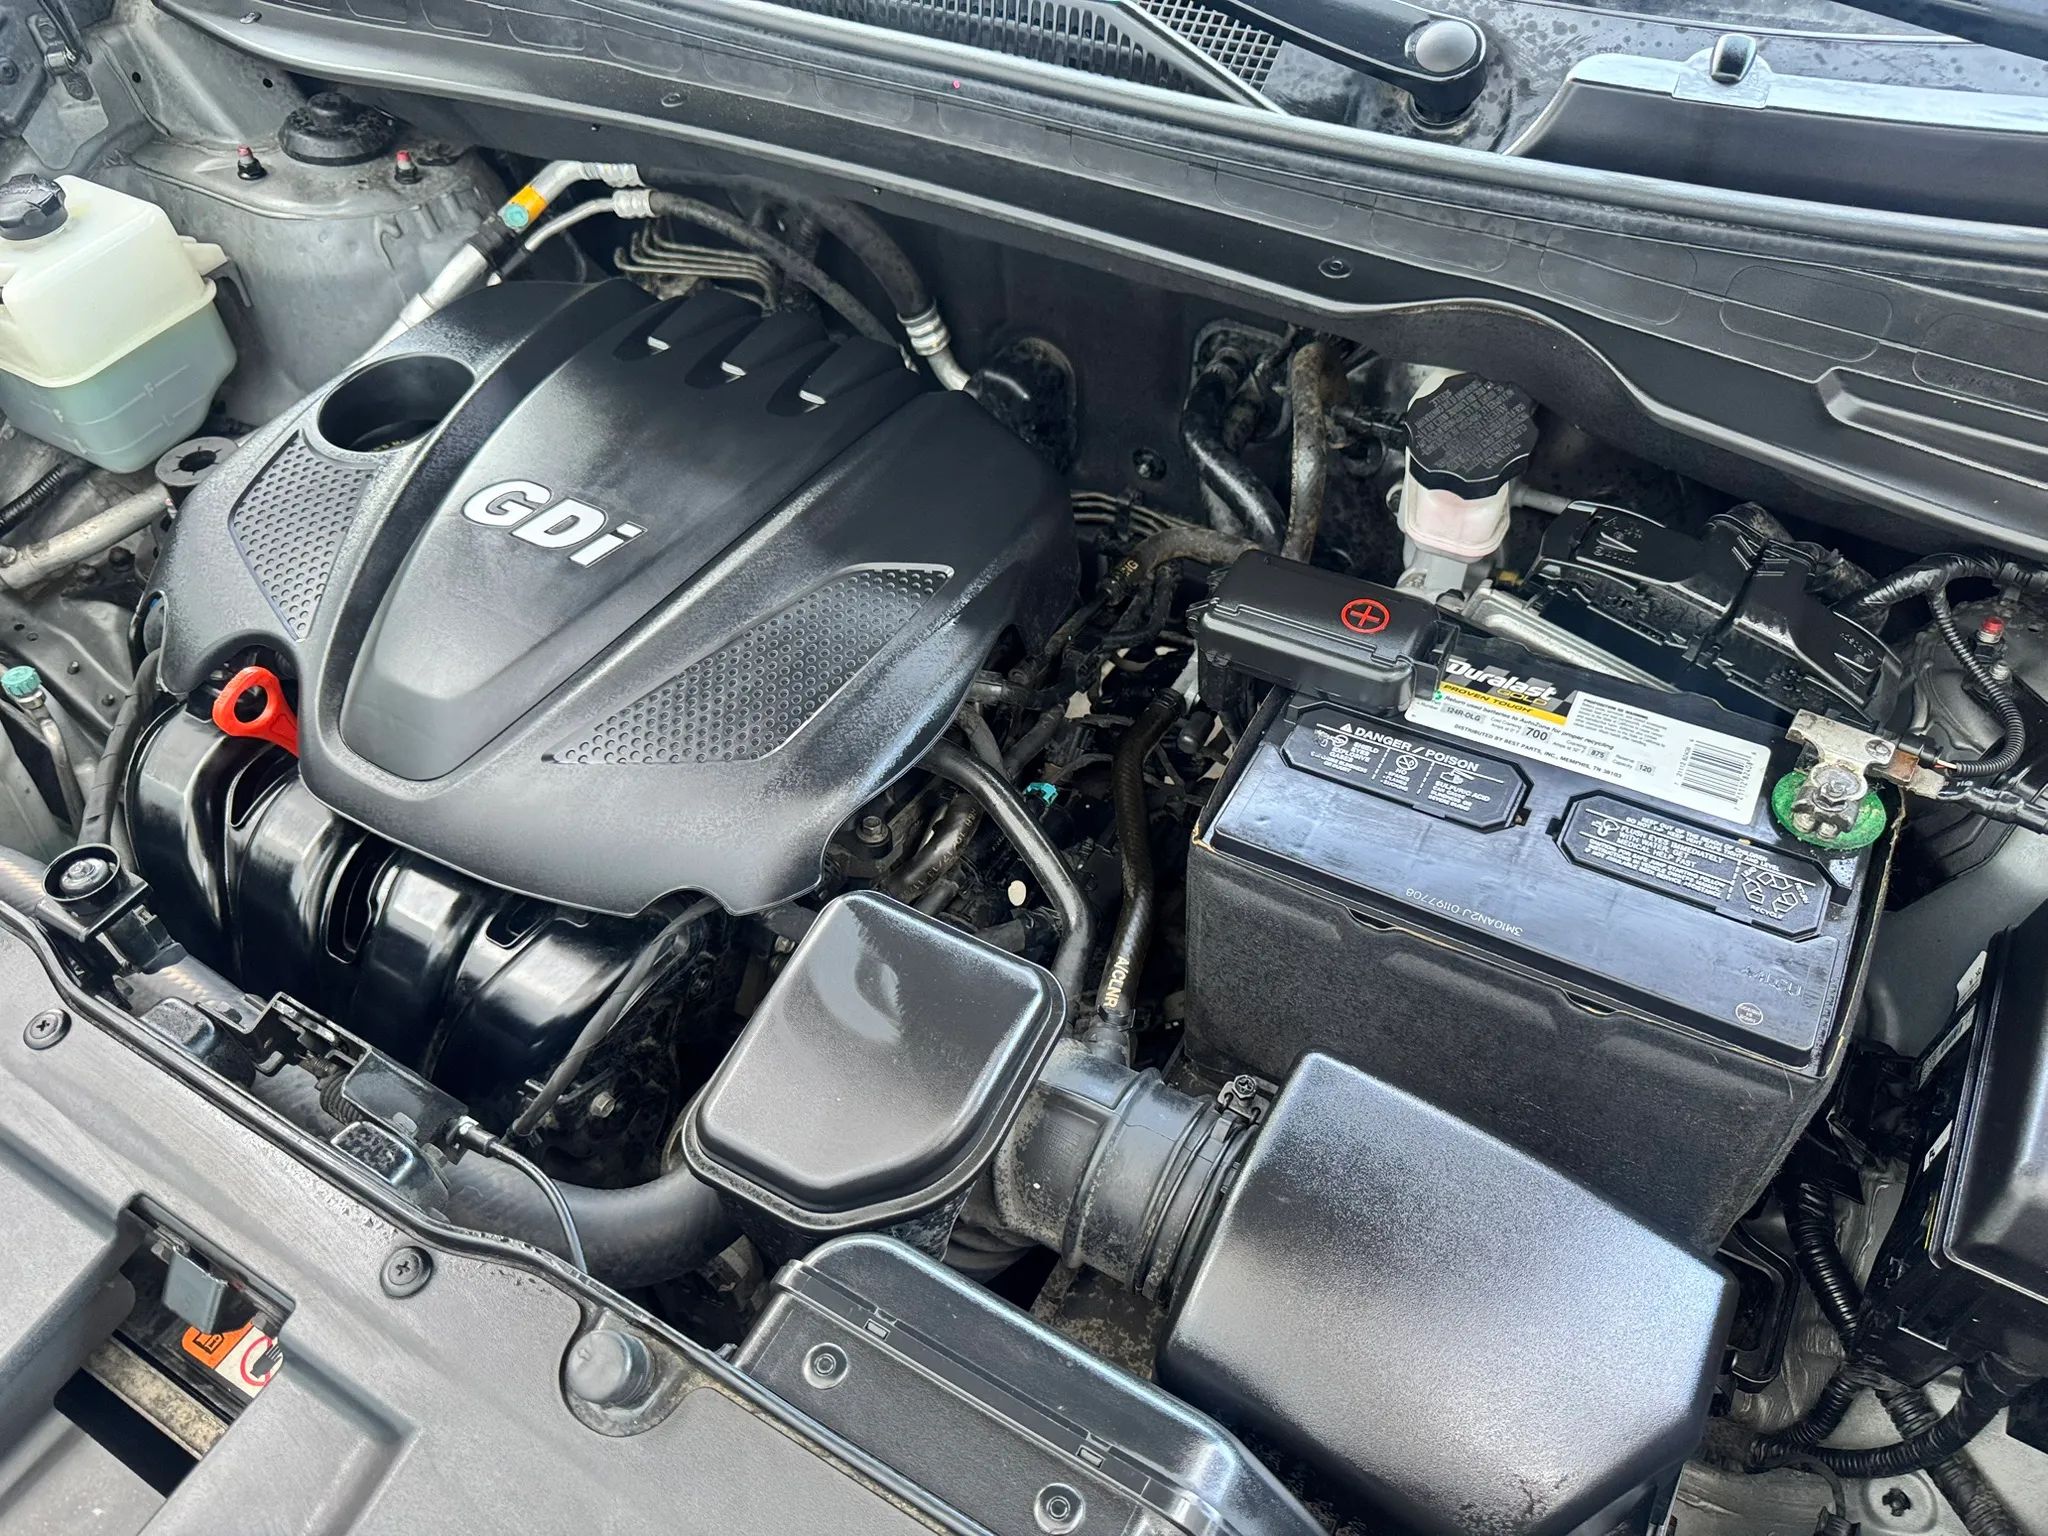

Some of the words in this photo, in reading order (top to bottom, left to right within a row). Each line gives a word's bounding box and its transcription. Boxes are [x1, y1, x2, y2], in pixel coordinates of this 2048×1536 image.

[461, 479, 648, 568] GDi
[1444, 658, 1557, 702] Duralast
[1443, 683, 1490, 701] PROVEN
[1493, 698, 1533, 713] TOUGH
[1496, 687, 1547, 706] GOLD
[1444, 695, 1466, 705] Return
[1482, 706, 1510, 718] batteries
[1519, 717, 1551, 730] AutoZone
[1560, 730, 1584, 741] proper
[1583, 738, 1614, 750] recycling
[1446, 706, 1481, 721] 124R-DLG
[1453, 723, 1493, 738] DISTRIBUTED
[1503, 738, 1519, 747] BEST
[1519, 743, 1543, 754] PARTS,
[1524, 726, 1548, 741] 700
[1354, 726, 1412, 751] DANGER
[1424, 748, 1479, 772] POISON
[1590, 749, 1605, 759] 875
[1394, 767, 1407, 775] NO
[1638, 764, 1652, 773] 120
[1434, 780, 1472, 796] SULFURIC
[1471, 791, 1491, 802] ACID
[1615, 837, 1651, 853] MEDICAL
[1652, 848, 1675, 861] HELP
[1674, 856, 1697, 868] FAST
[1618, 831, 1639, 843] WITH
[1671, 848, 1689, 859] GET
[1620, 825, 1647, 838] FLUSH
[1647, 833, 1669, 846] EYES
[1670, 841, 1725, 864] IMMEDIATELY
[1734, 846, 1768, 862] CHILDREN
[1759, 860, 1781, 871] LEVEL
[1750, 904, 1784, 920] RECYCLE
[1103, 955, 1130, 1008] A/CLNR
